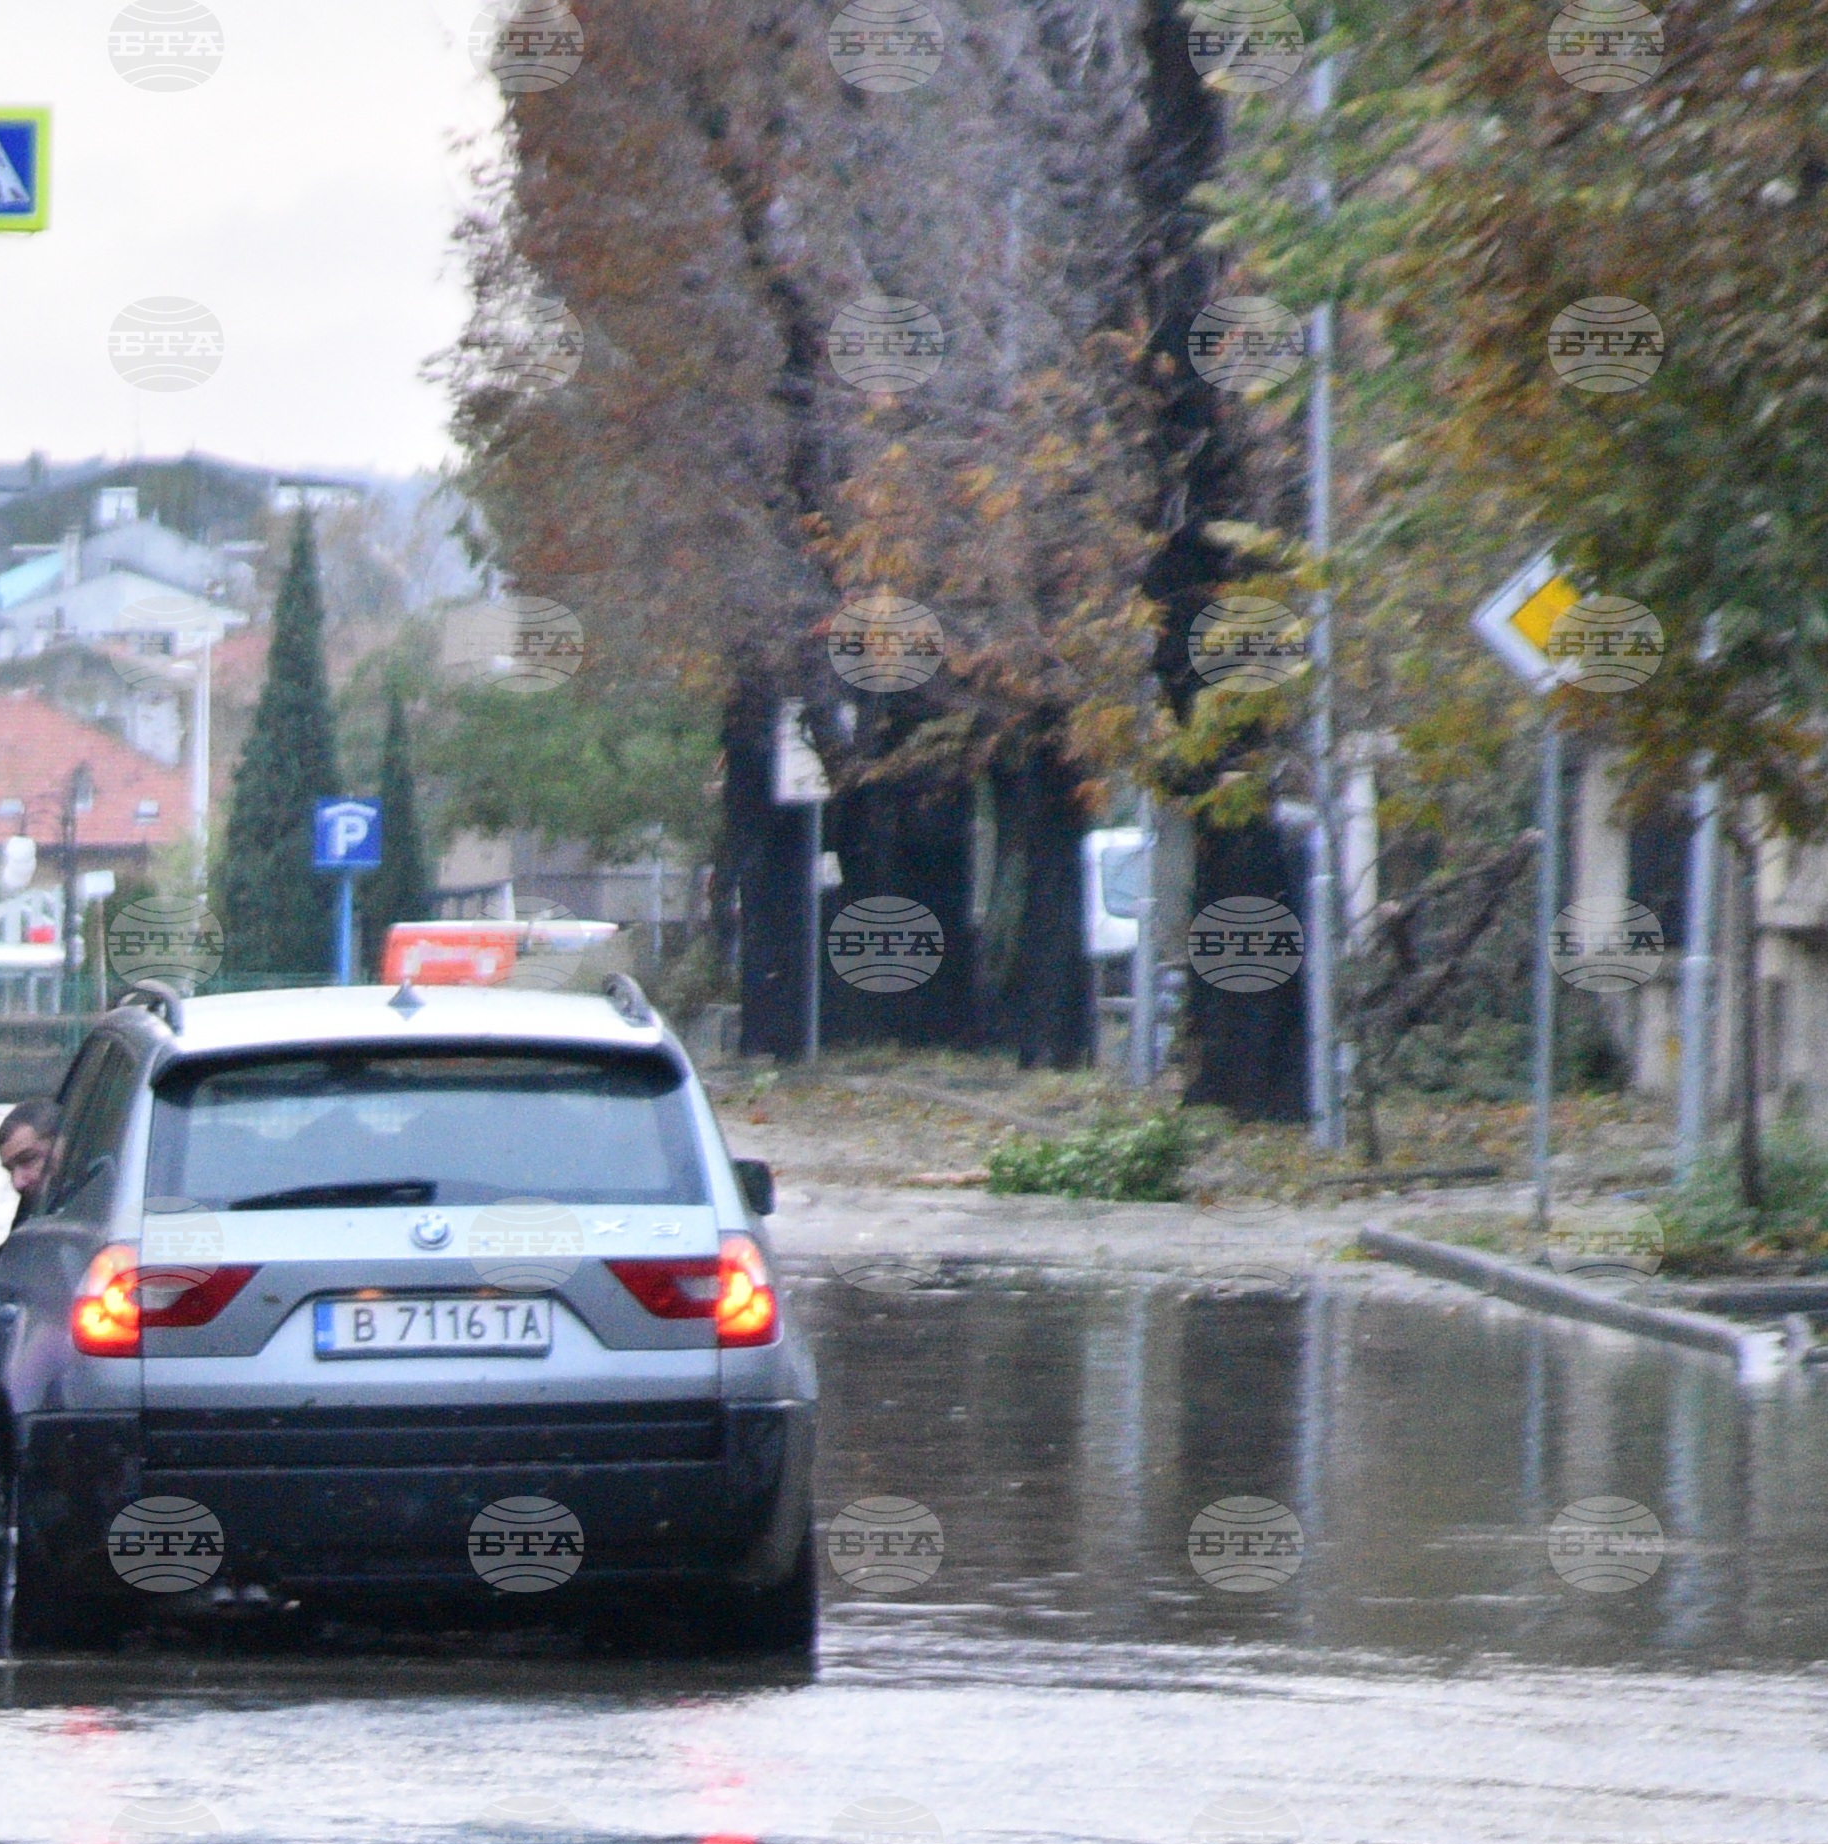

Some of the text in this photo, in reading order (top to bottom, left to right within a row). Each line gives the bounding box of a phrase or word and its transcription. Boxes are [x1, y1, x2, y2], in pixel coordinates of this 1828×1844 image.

[333, 814, 369, 857] P
[354, 1304, 543, 1342] B 7116 TA
